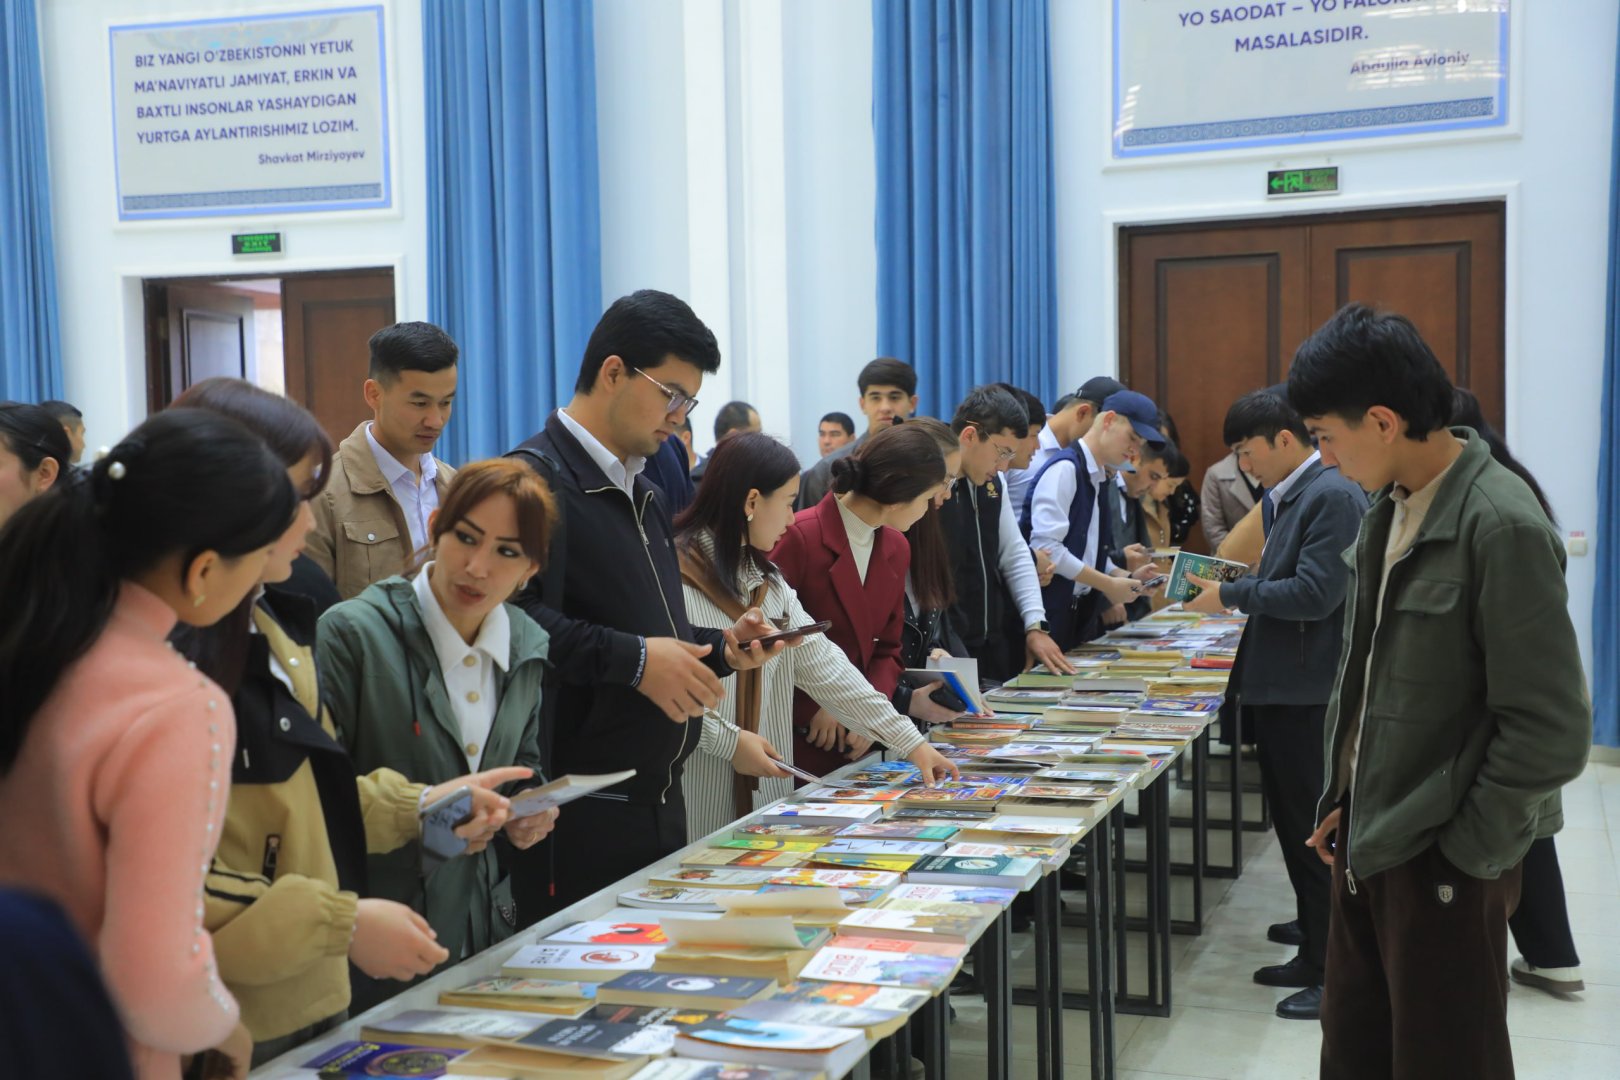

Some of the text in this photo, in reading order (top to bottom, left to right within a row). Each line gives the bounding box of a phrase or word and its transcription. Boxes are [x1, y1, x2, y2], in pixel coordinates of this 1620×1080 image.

[1178, 11, 1205, 27] YO
[1209, 2, 1287, 24] SAODAT
[1310, 0, 1337, 13] YO
[1234, 25, 1370, 52] MASALASIDIR.
[134, 54, 156, 68] BIZ
[158, 51, 201, 66] YANGI
[310, 39, 354, 55] YETUK
[229, 71, 291, 88] JAMIYAT,
[294, 68, 334, 83] ERKIN
[337, 66, 358, 79] VA
[136, 93, 357, 119] BAXTLI INSONLAR YASHAYDIGAN
[136, 119, 359, 144] YURTGA AYLANTIRISHIMIZ LOZIM.
[258, 149, 365, 165] Shavkat Mirziyoyev
